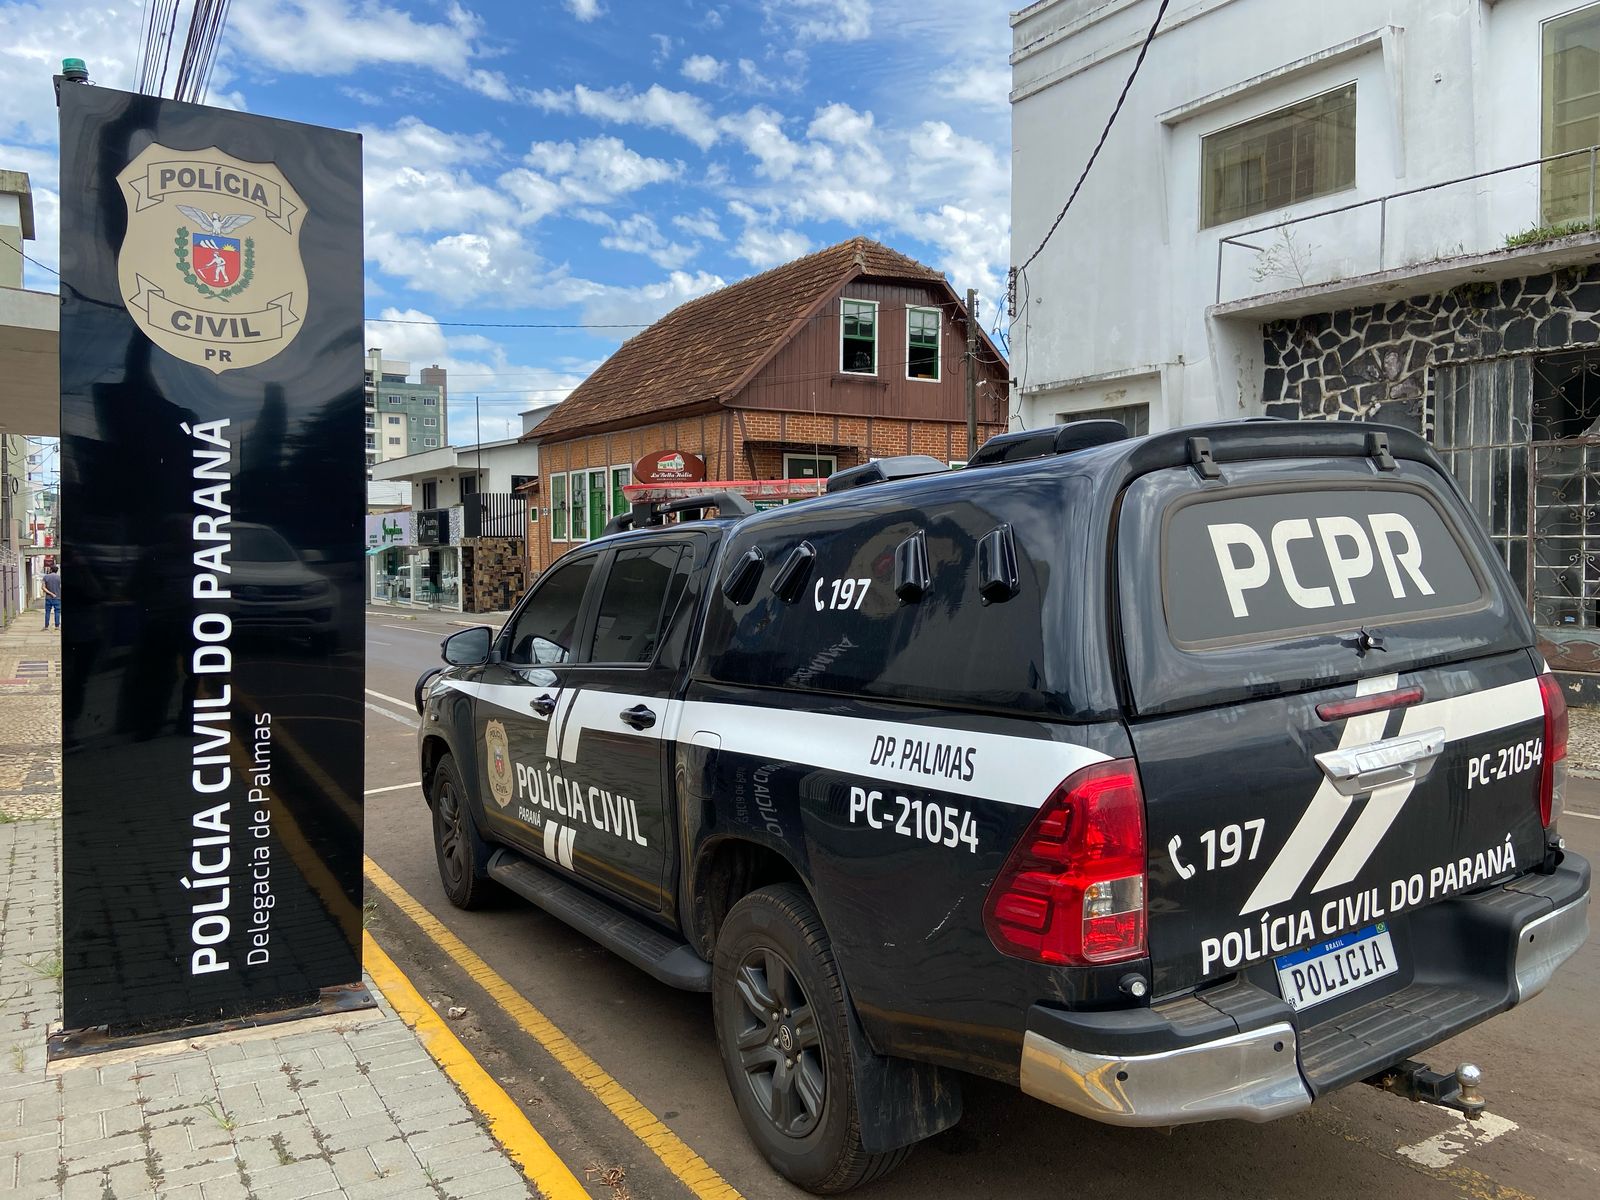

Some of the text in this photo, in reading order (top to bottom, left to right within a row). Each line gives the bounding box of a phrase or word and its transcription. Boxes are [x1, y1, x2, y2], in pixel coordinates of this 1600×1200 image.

[160, 166, 269, 207] POLÍCIA
[171, 310, 261, 338] CIVIL
[204, 348, 233, 363] PR
[1208, 513, 1436, 618] PCPR
[829, 577, 872, 611] 197
[179, 418, 232, 975] POLÍCIA CIVIL DO PARANÁ
[870, 735, 977, 782] DP. PALMAS
[1467, 736, 1544, 791] PC-21054
[515, 760, 648, 847] POLÍCIA CIVIL
[518, 806, 542, 827] PARANÁ
[849, 786, 980, 854] PC-21054
[247, 712, 276, 965] Delegacia de Palmas
[1200, 818, 1266, 872] 197
[1201, 833, 1516, 976] POLÍCIA CIVIL DO PARANÁ
[1291, 940, 1387, 1002] POLICIA
[1325, 939, 1345, 952] BRASIL
